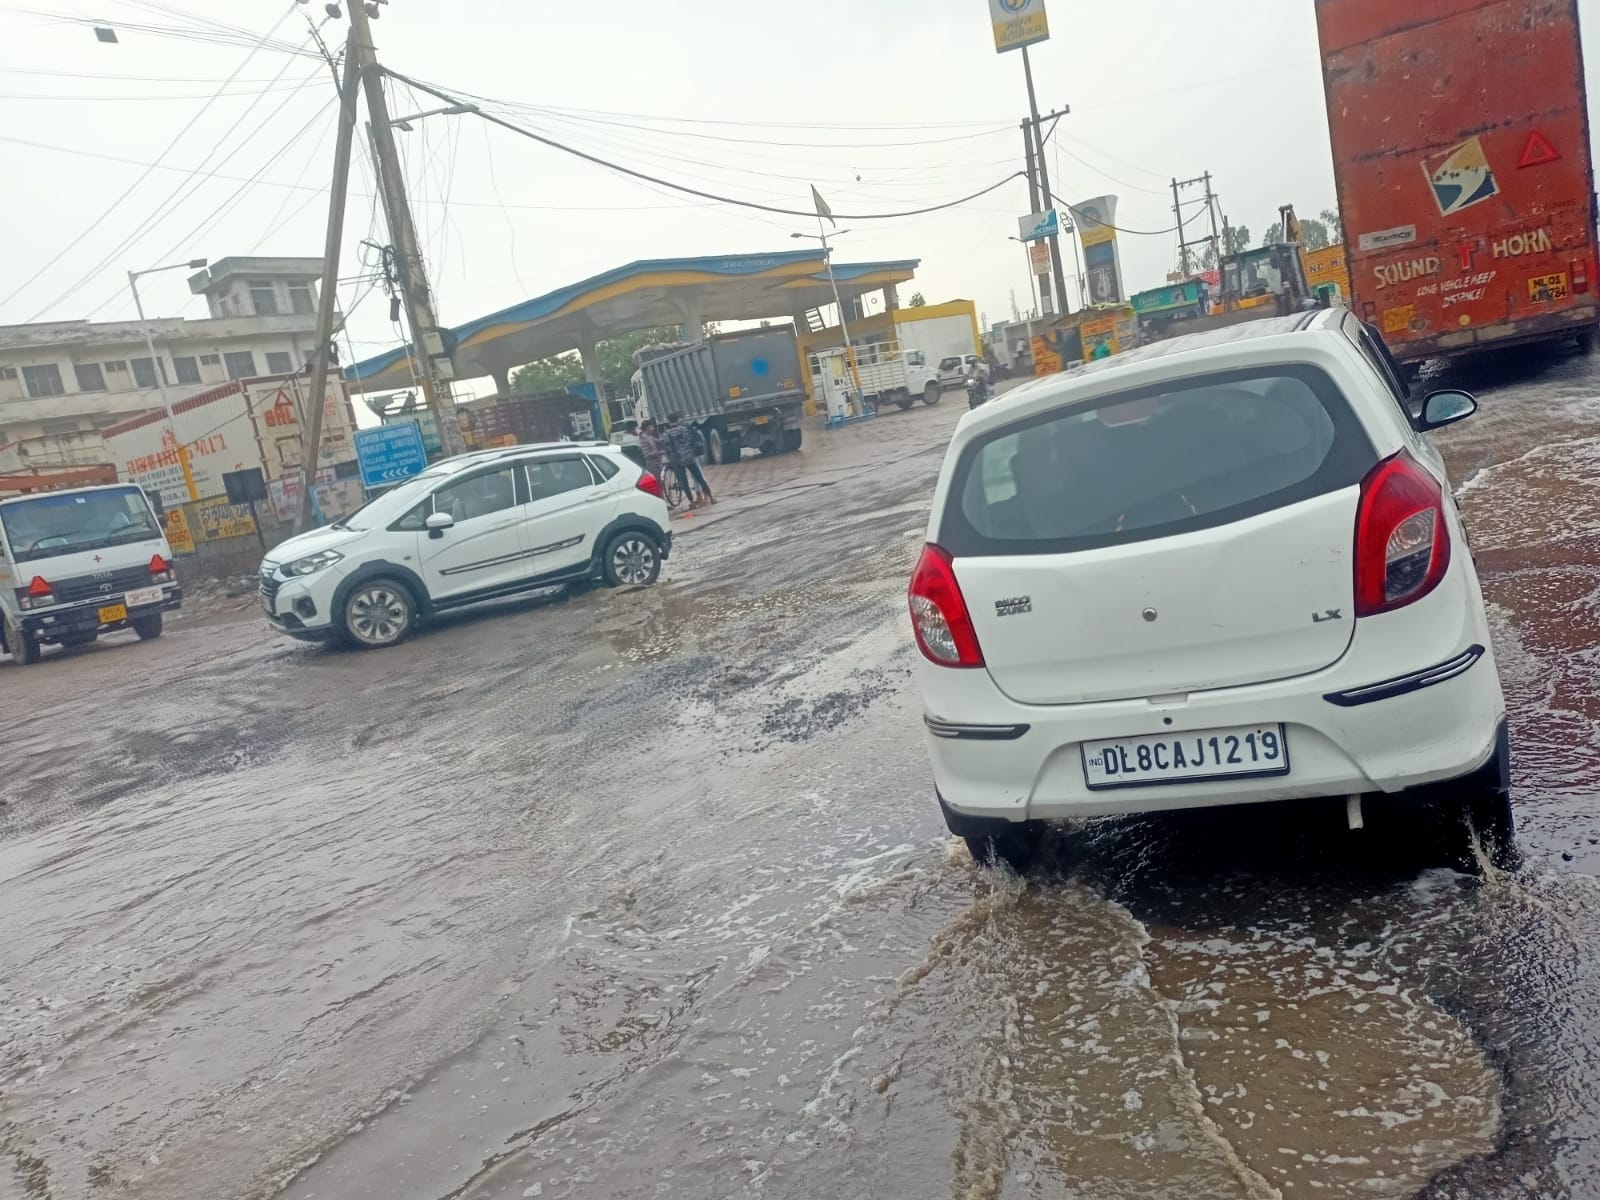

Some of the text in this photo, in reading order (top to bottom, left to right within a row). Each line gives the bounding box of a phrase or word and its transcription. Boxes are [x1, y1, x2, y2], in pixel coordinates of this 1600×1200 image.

[1492, 228, 1552, 258] HORN
[1374, 257, 1440, 290] SOUND
[1470, 271, 1496, 286] KEEP
[1102, 731, 1280, 776] DL8CAJ1219
